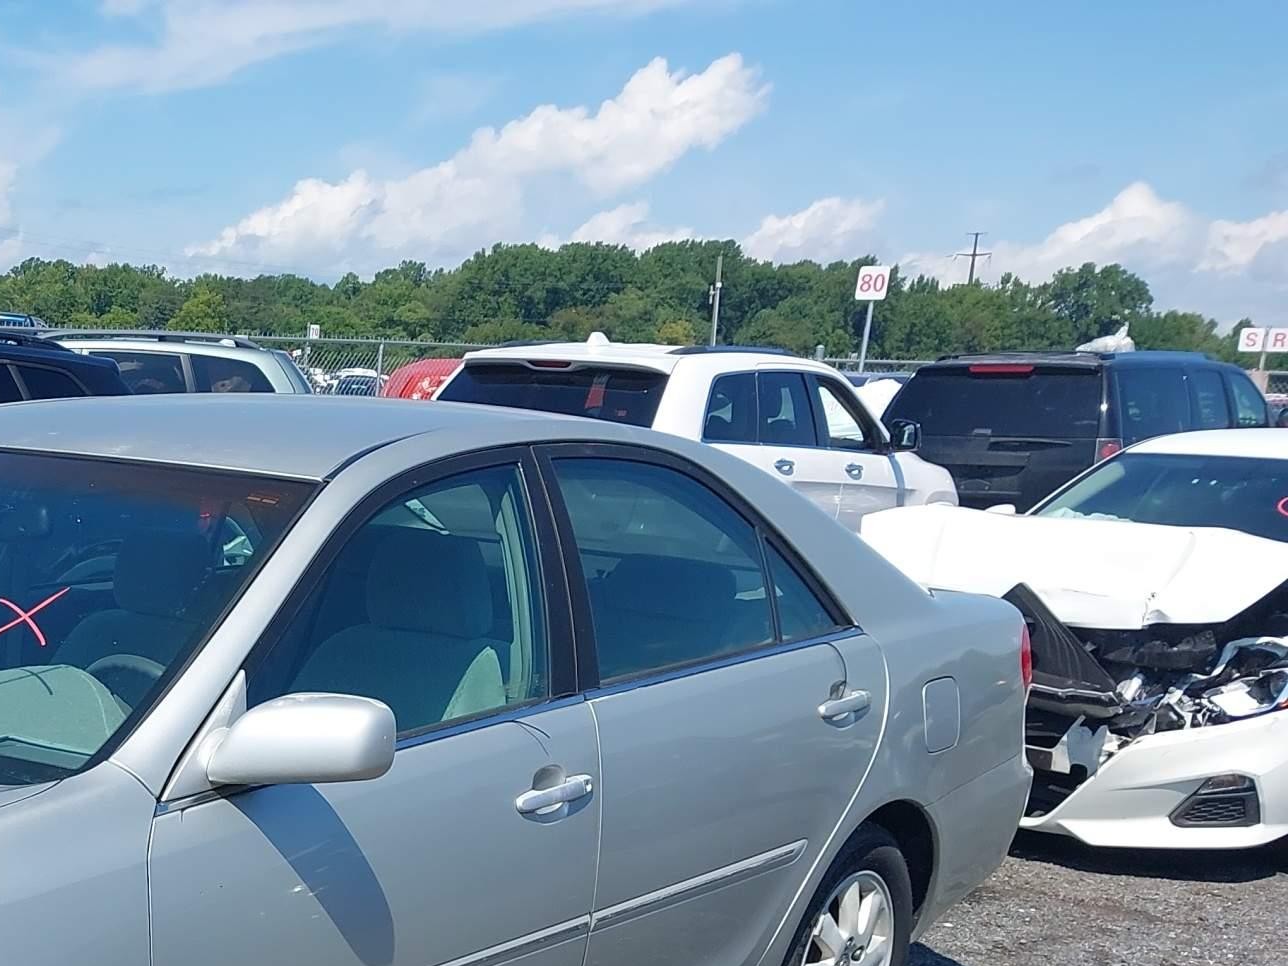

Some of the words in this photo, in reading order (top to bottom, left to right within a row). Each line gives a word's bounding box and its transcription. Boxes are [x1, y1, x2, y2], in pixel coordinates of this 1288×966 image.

[860, 273, 886, 292] 80
[1245, 332, 1259, 348] S
[1272, 332, 1288, 348] R
